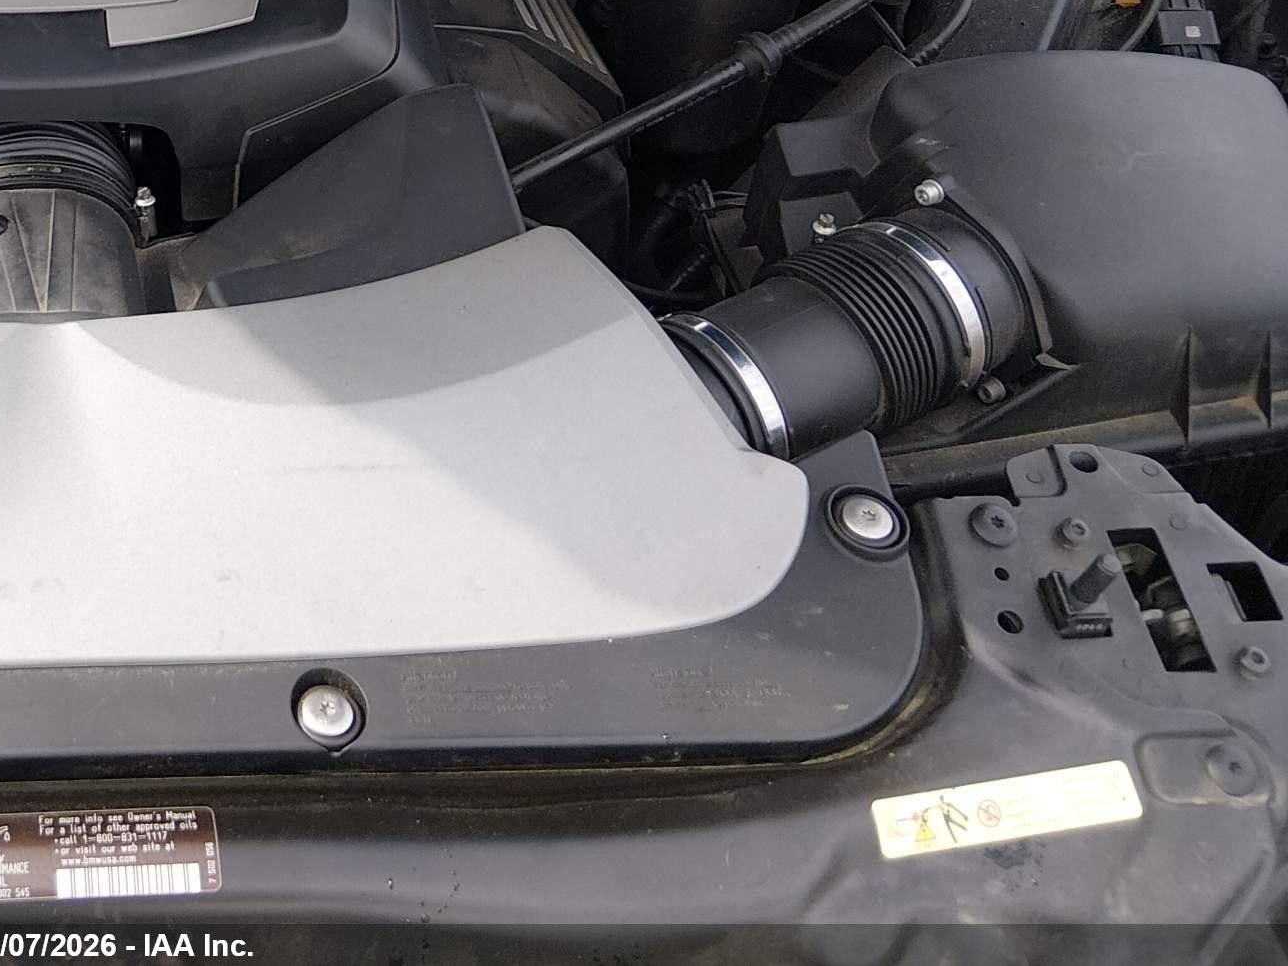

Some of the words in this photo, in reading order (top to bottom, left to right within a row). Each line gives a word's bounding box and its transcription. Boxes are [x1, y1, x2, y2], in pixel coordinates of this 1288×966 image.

[38, 814, 53, 825] For
[59, 816, 80, 824] more
[85, 813, 103, 823] info
[108, 814, 123, 822] see
[127, 811, 161, 822] Owner's
[165, 810, 196, 820] Manual
[39, 824, 54, 836] For
[59, 827, 66, 835] a
[70, 823, 87, 834] list
[91, 822, 101, 833] of
[106, 822, 130, 832] other
[135, 820, 175, 833] approved
[179, 819, 198, 831] oils
[83, 831, 167, 843] 1-800-831-1117
[75, 844, 96, 854] visit
[101, 846, 115, 854] our
[121, 843, 138, 853] web
[142, 841, 161, 852] site
[165, 840, 175, 851] at
[61, 855, 137, 866] www.bmwusa.com
